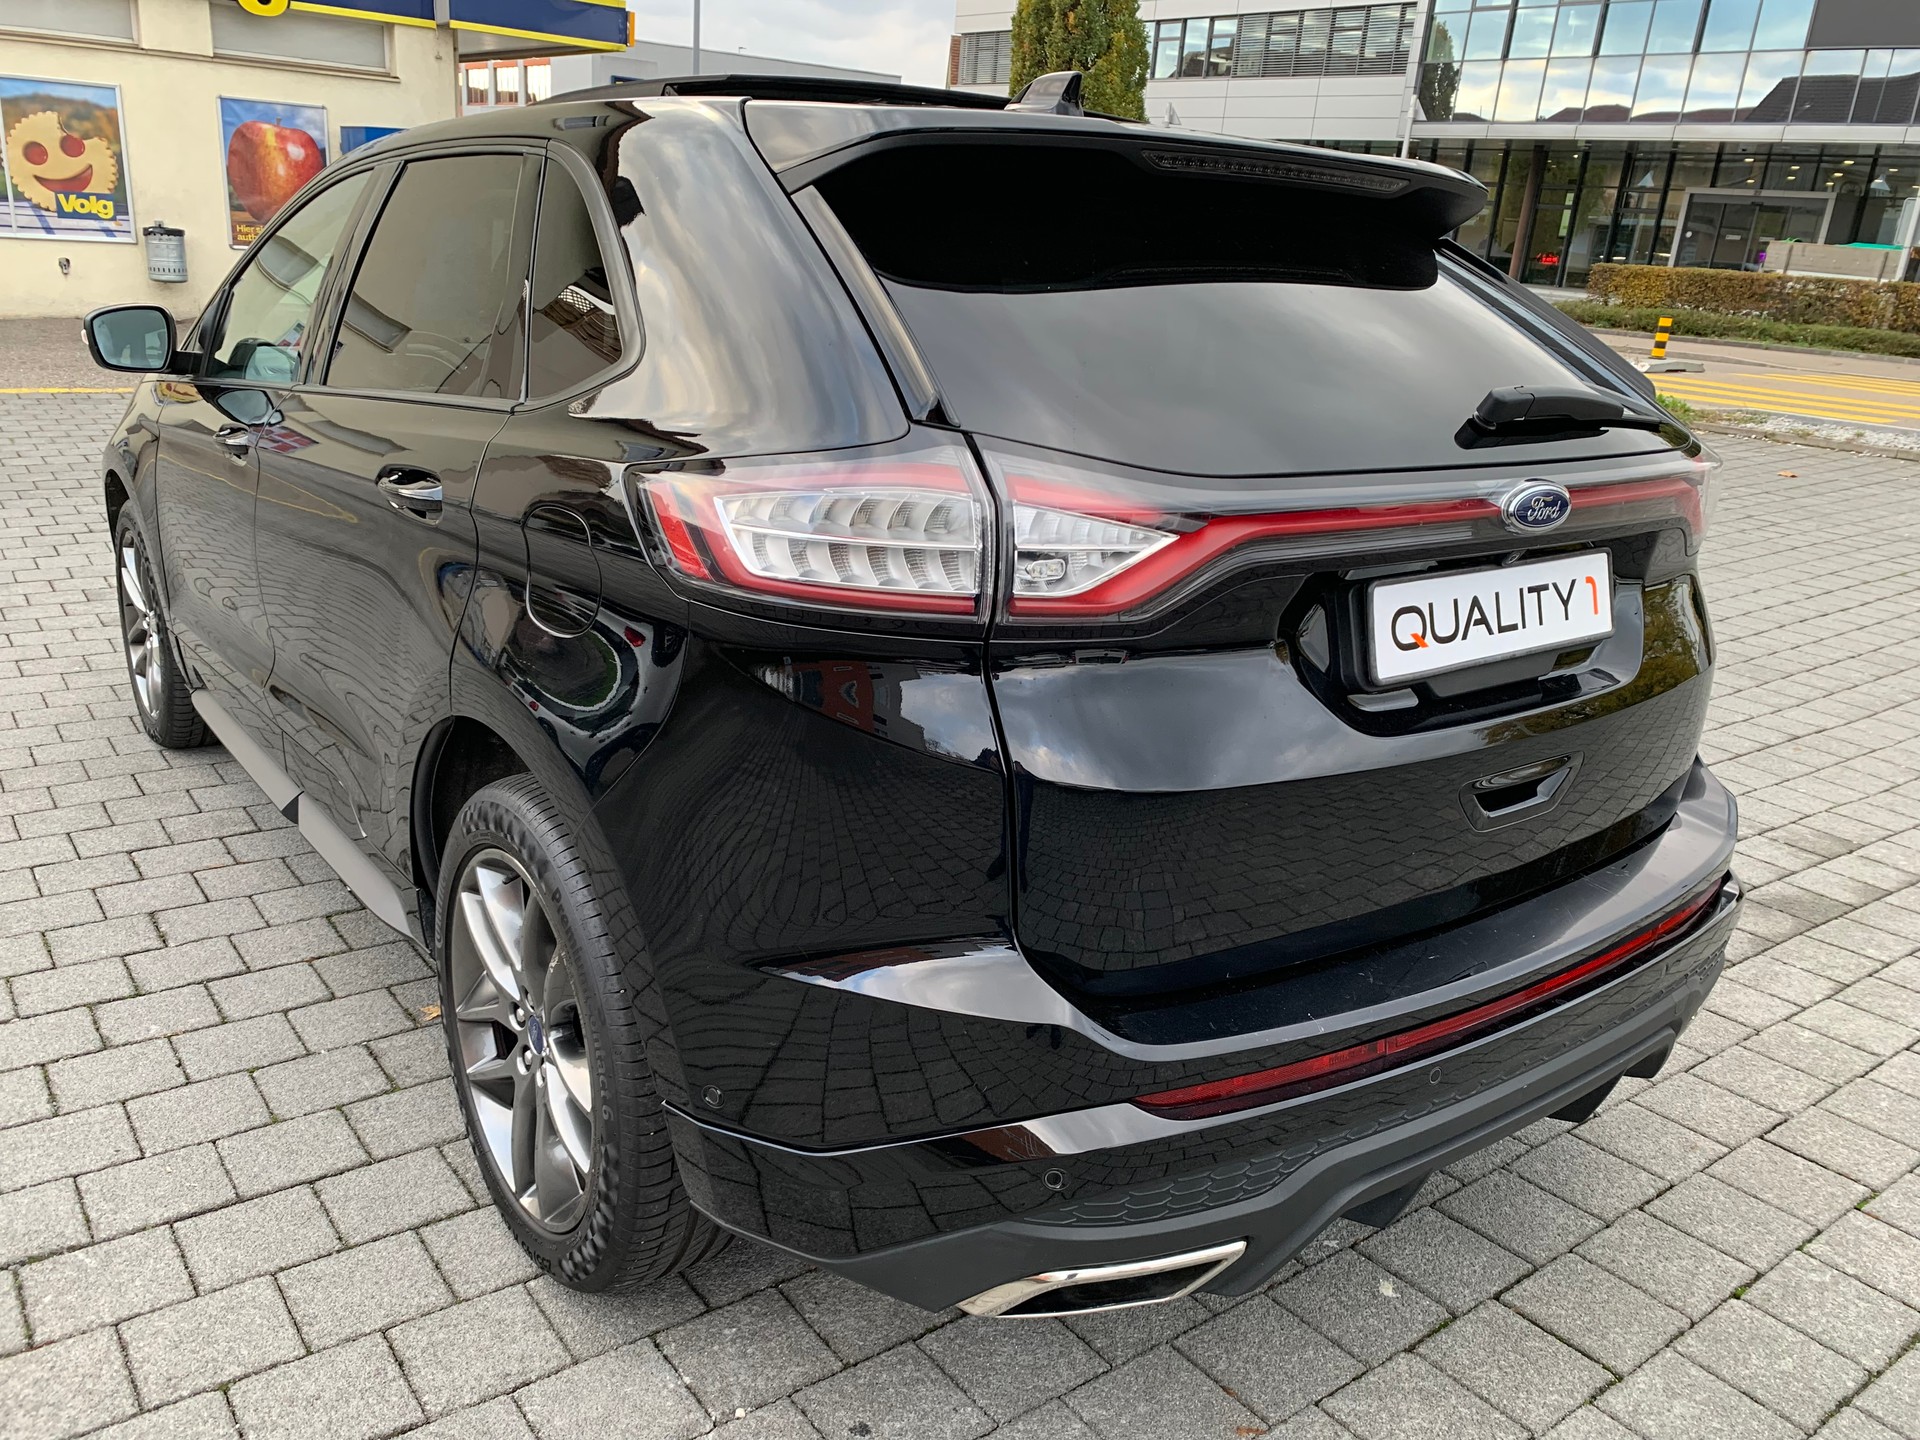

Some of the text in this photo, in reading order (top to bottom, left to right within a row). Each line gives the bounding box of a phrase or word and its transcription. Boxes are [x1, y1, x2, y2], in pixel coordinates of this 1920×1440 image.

[57, 194, 114, 219] Volg
[236, 224, 255, 233] Hier
[237, 233, 256, 241] auth
[1527, 496, 1562, 521] Ford
